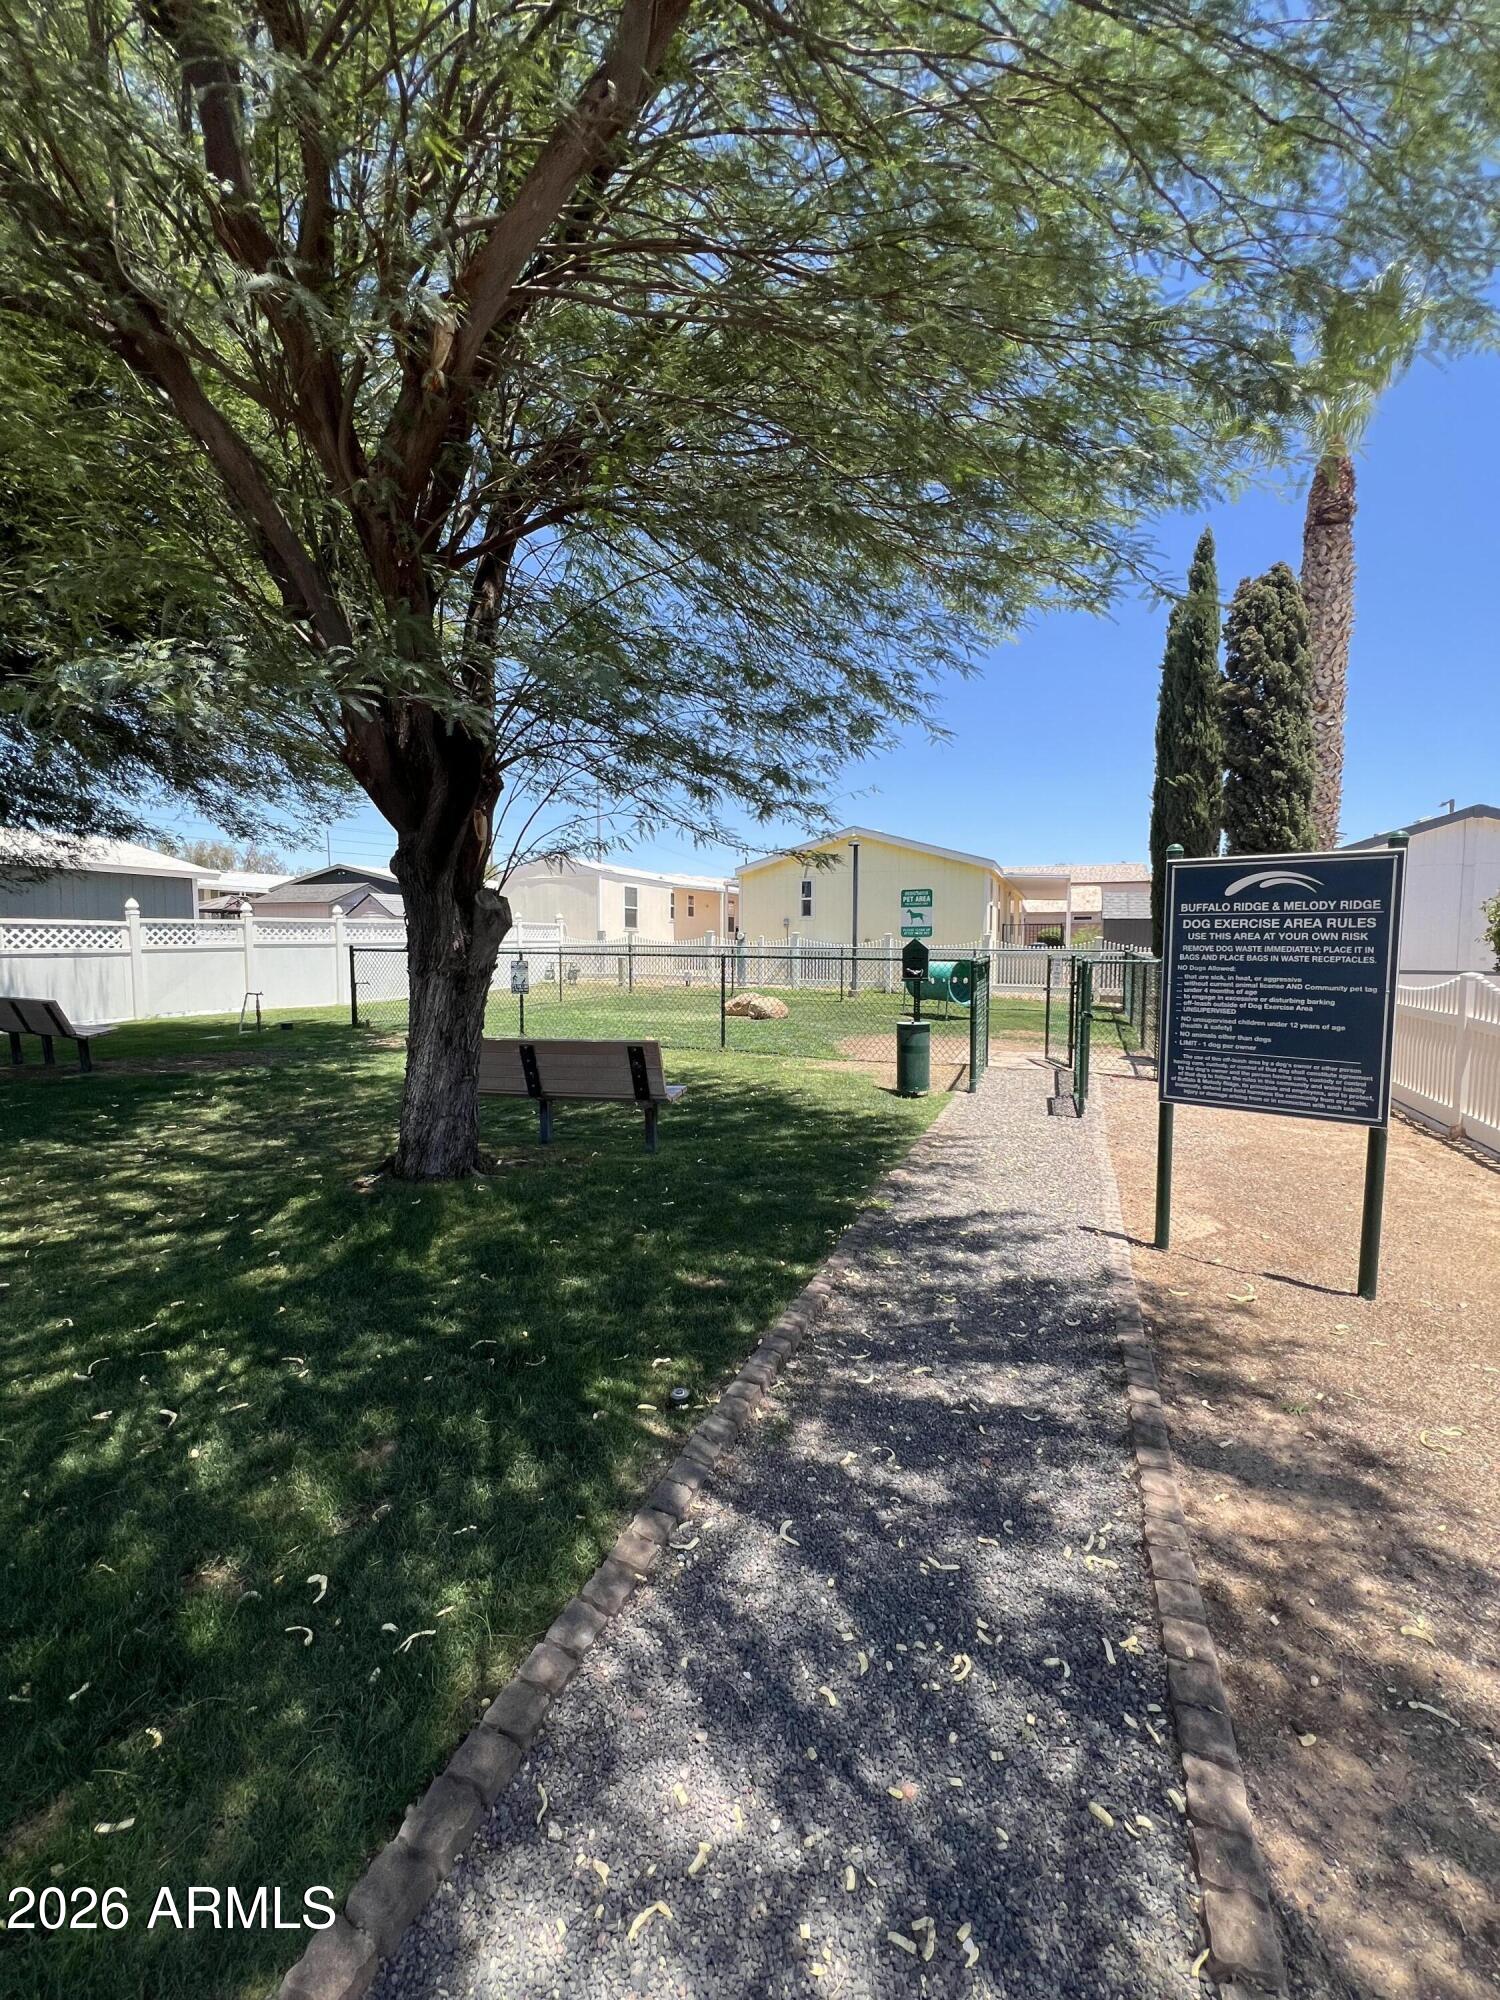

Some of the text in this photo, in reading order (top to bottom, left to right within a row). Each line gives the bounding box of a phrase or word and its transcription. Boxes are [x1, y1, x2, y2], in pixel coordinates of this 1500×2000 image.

[1181, 900, 1381, 912] BUFFALO RIDGE & MELODY RIDGE
[1183, 918, 1376, 928] DOG EXERCISE AREA RULES
[1278, 932, 1308, 940] YOUR
[1342, 932, 1368, 940] RISK
[1264, 945, 1321, 954] IMMEDIATELY;
[1305, 984, 1348, 992] Community
[1269, 997, 1305, 1005] disturbing
